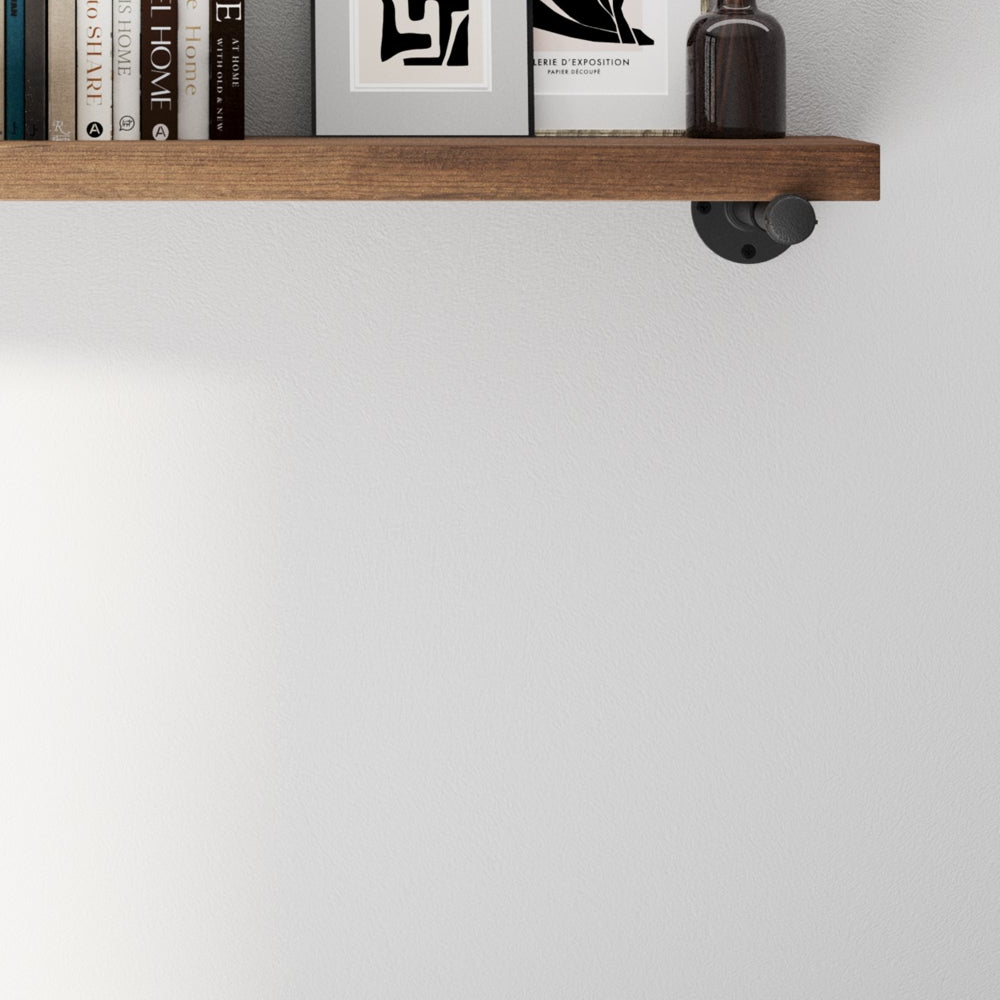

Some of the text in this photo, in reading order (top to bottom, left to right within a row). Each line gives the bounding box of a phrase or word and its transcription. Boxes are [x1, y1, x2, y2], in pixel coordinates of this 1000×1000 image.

[86, 0, 101, 19] to
[117, 0, 132, 14] IS
[117, 20, 132, 77] HOME
[185, 25, 202, 97] Home
[216, 38, 224, 69] WITH
[232, 39, 240, 88] AT HOME
[561, 58, 630, 67] D'EXPOSITION
[86, 26, 102, 106] SHARE
[150, 26, 172, 111] HOME
[216, 71, 224, 94] OLD
[216, 107, 224, 132] NEW
